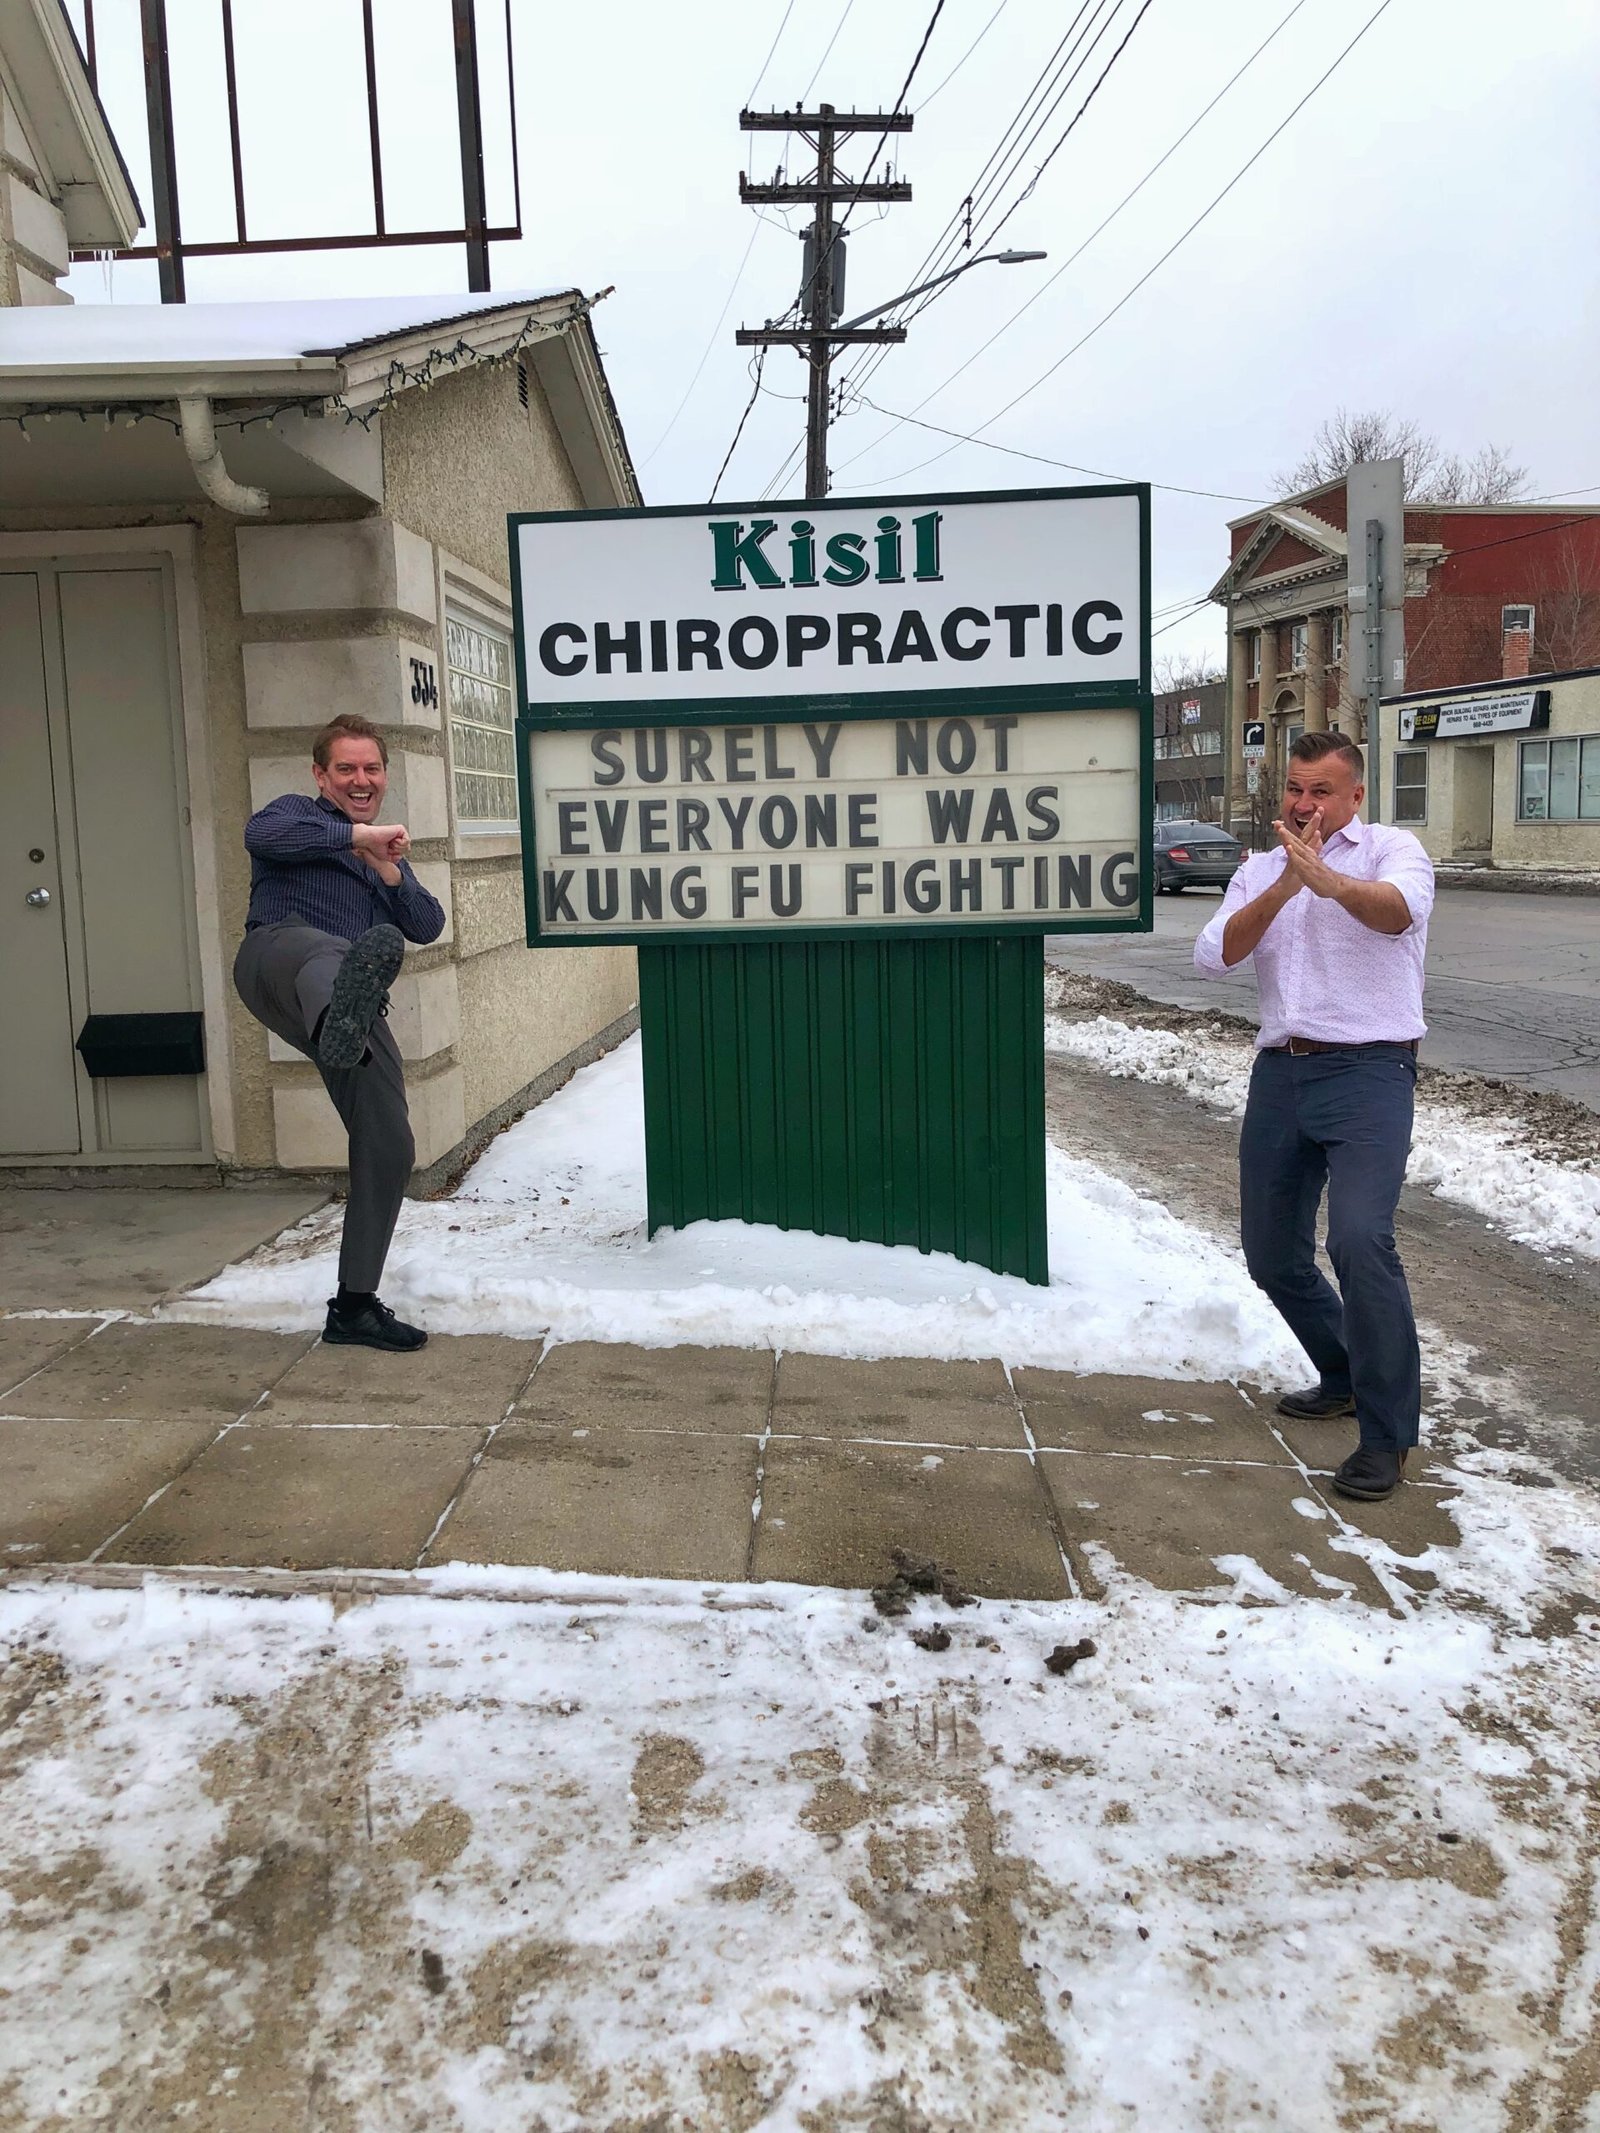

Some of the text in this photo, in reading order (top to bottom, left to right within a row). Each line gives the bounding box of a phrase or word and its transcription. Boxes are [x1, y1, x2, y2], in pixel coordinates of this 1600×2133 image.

[708, 511, 944, 591] Kisil
[539, 600, 1123, 677] CHIROPRACTIC
[409, 657, 438, 710] 334
[1446, 715, 1462, 723] REPAIRS
[1478, 712, 1490, 720] TYPES
[1454, 706, 1471, 715] BUILDING
[1473, 704, 1490, 712] REPAIRS
[591, 717, 1018, 786] SURELY NOT
[558, 786, 1060, 855] EVERYONE WAS
[542, 851, 1139, 922] KUNG FU FIGHTING
